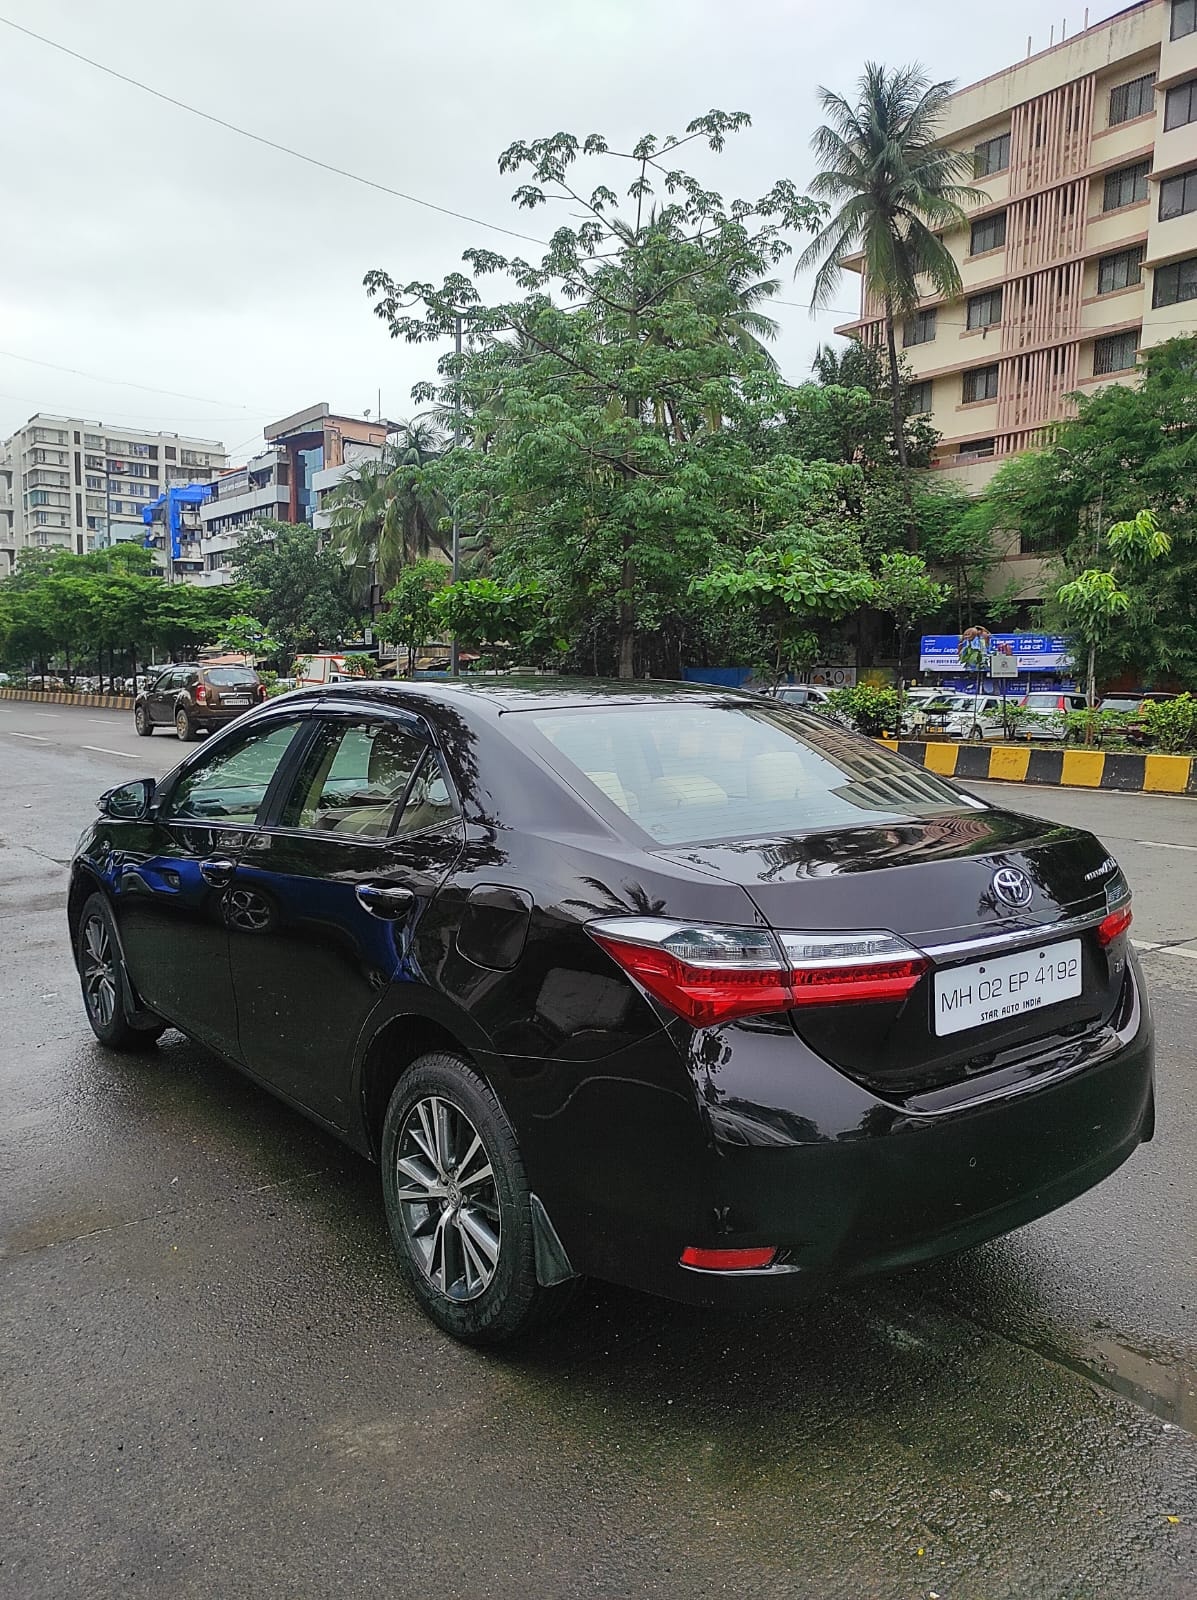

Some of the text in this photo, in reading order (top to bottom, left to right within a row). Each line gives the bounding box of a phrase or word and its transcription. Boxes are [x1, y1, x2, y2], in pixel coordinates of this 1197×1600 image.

[941, 959, 1078, 1012] MH 02 EP 4192
[980, 996, 1042, 1021] STAR AUTO INDIA
